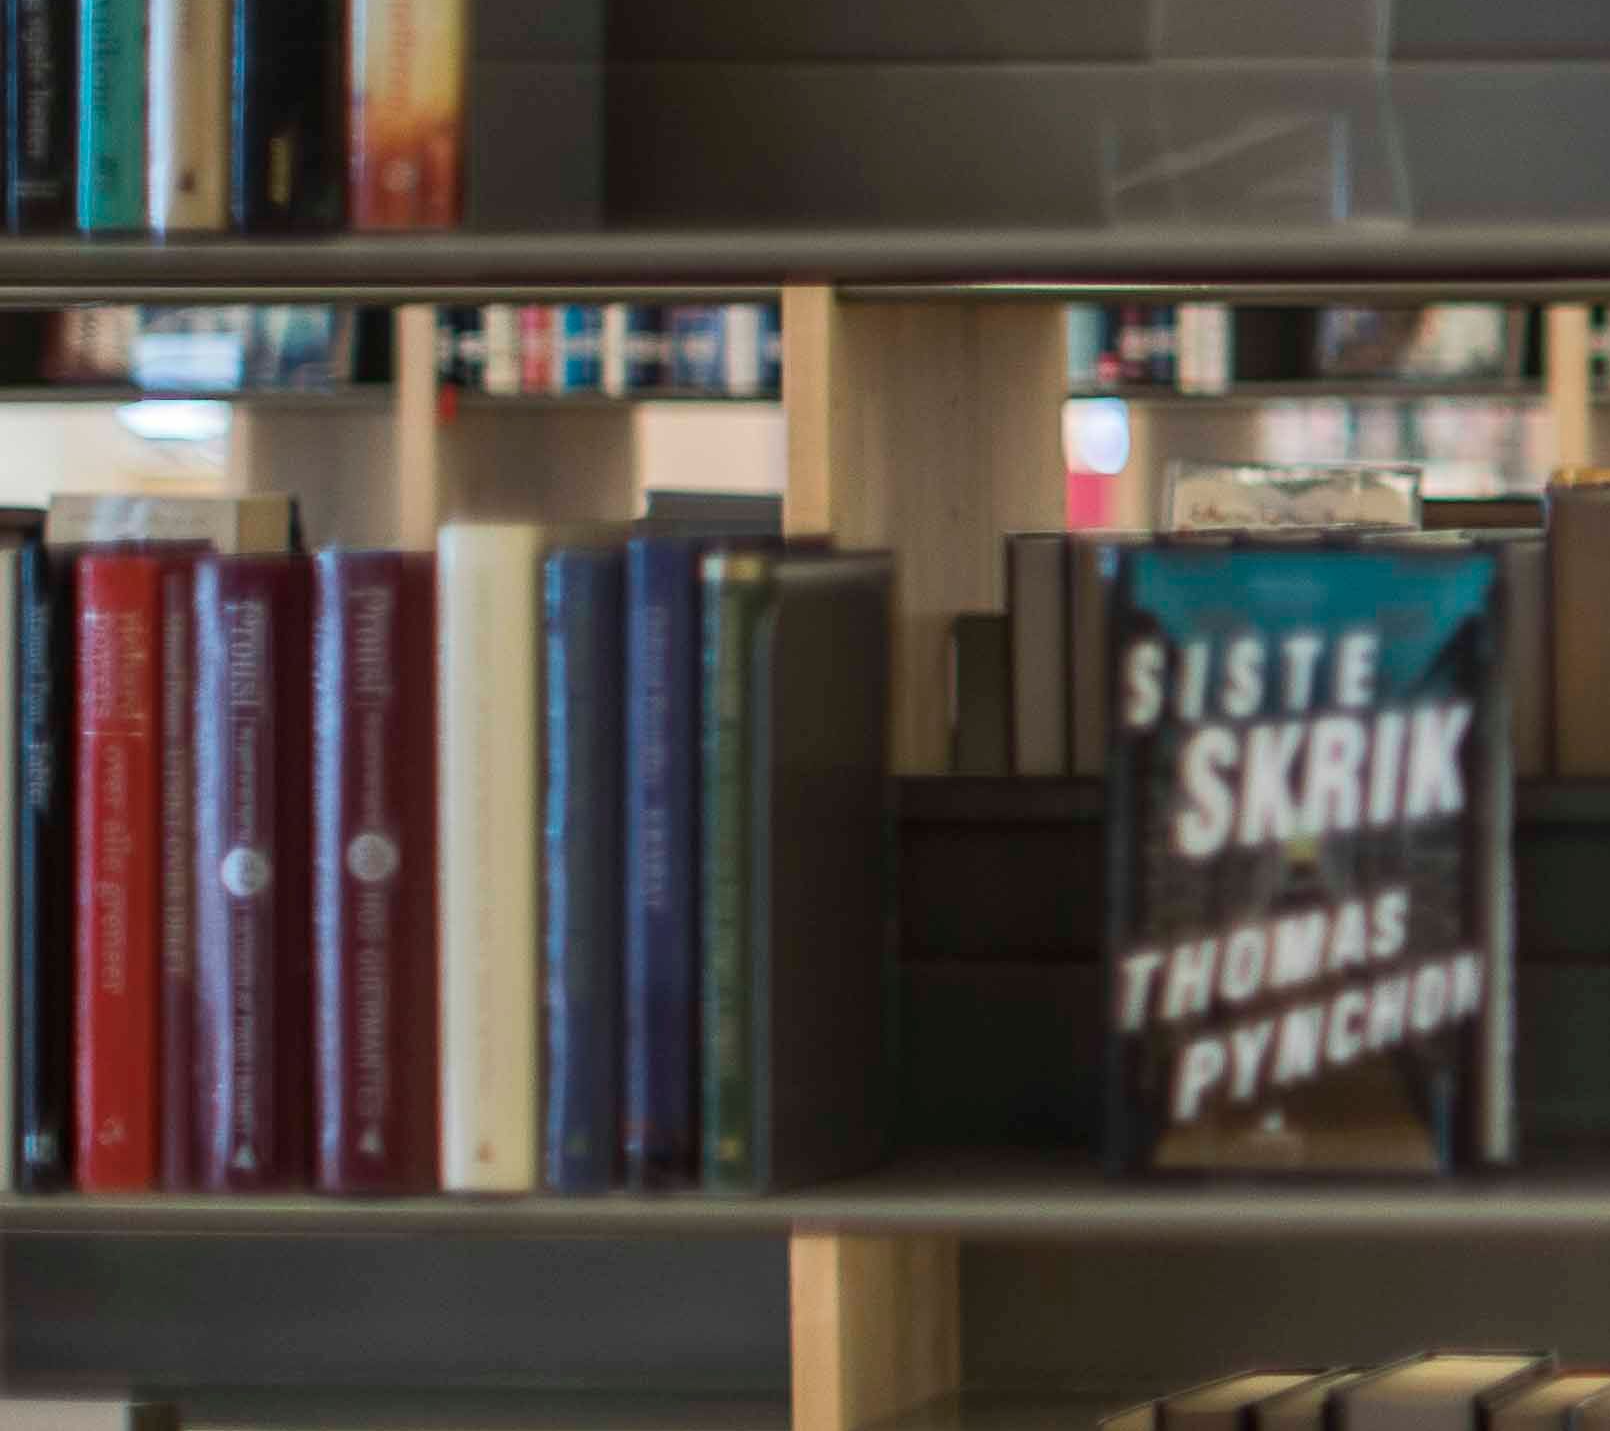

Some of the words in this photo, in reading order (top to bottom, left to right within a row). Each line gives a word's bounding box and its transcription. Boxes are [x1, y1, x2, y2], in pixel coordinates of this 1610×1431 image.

[225, 599, 267, 709] Proust
[350, 585, 393, 698] Proust
[1124, 629, 1381, 728] SISTE
[1176, 703, 1474, 859] SKRIK
[94, 881, 127, 995] grenser
[1118, 889, 1410, 1032] THOMAS
[1172, 951, 1486, 1122] PYNCHON
